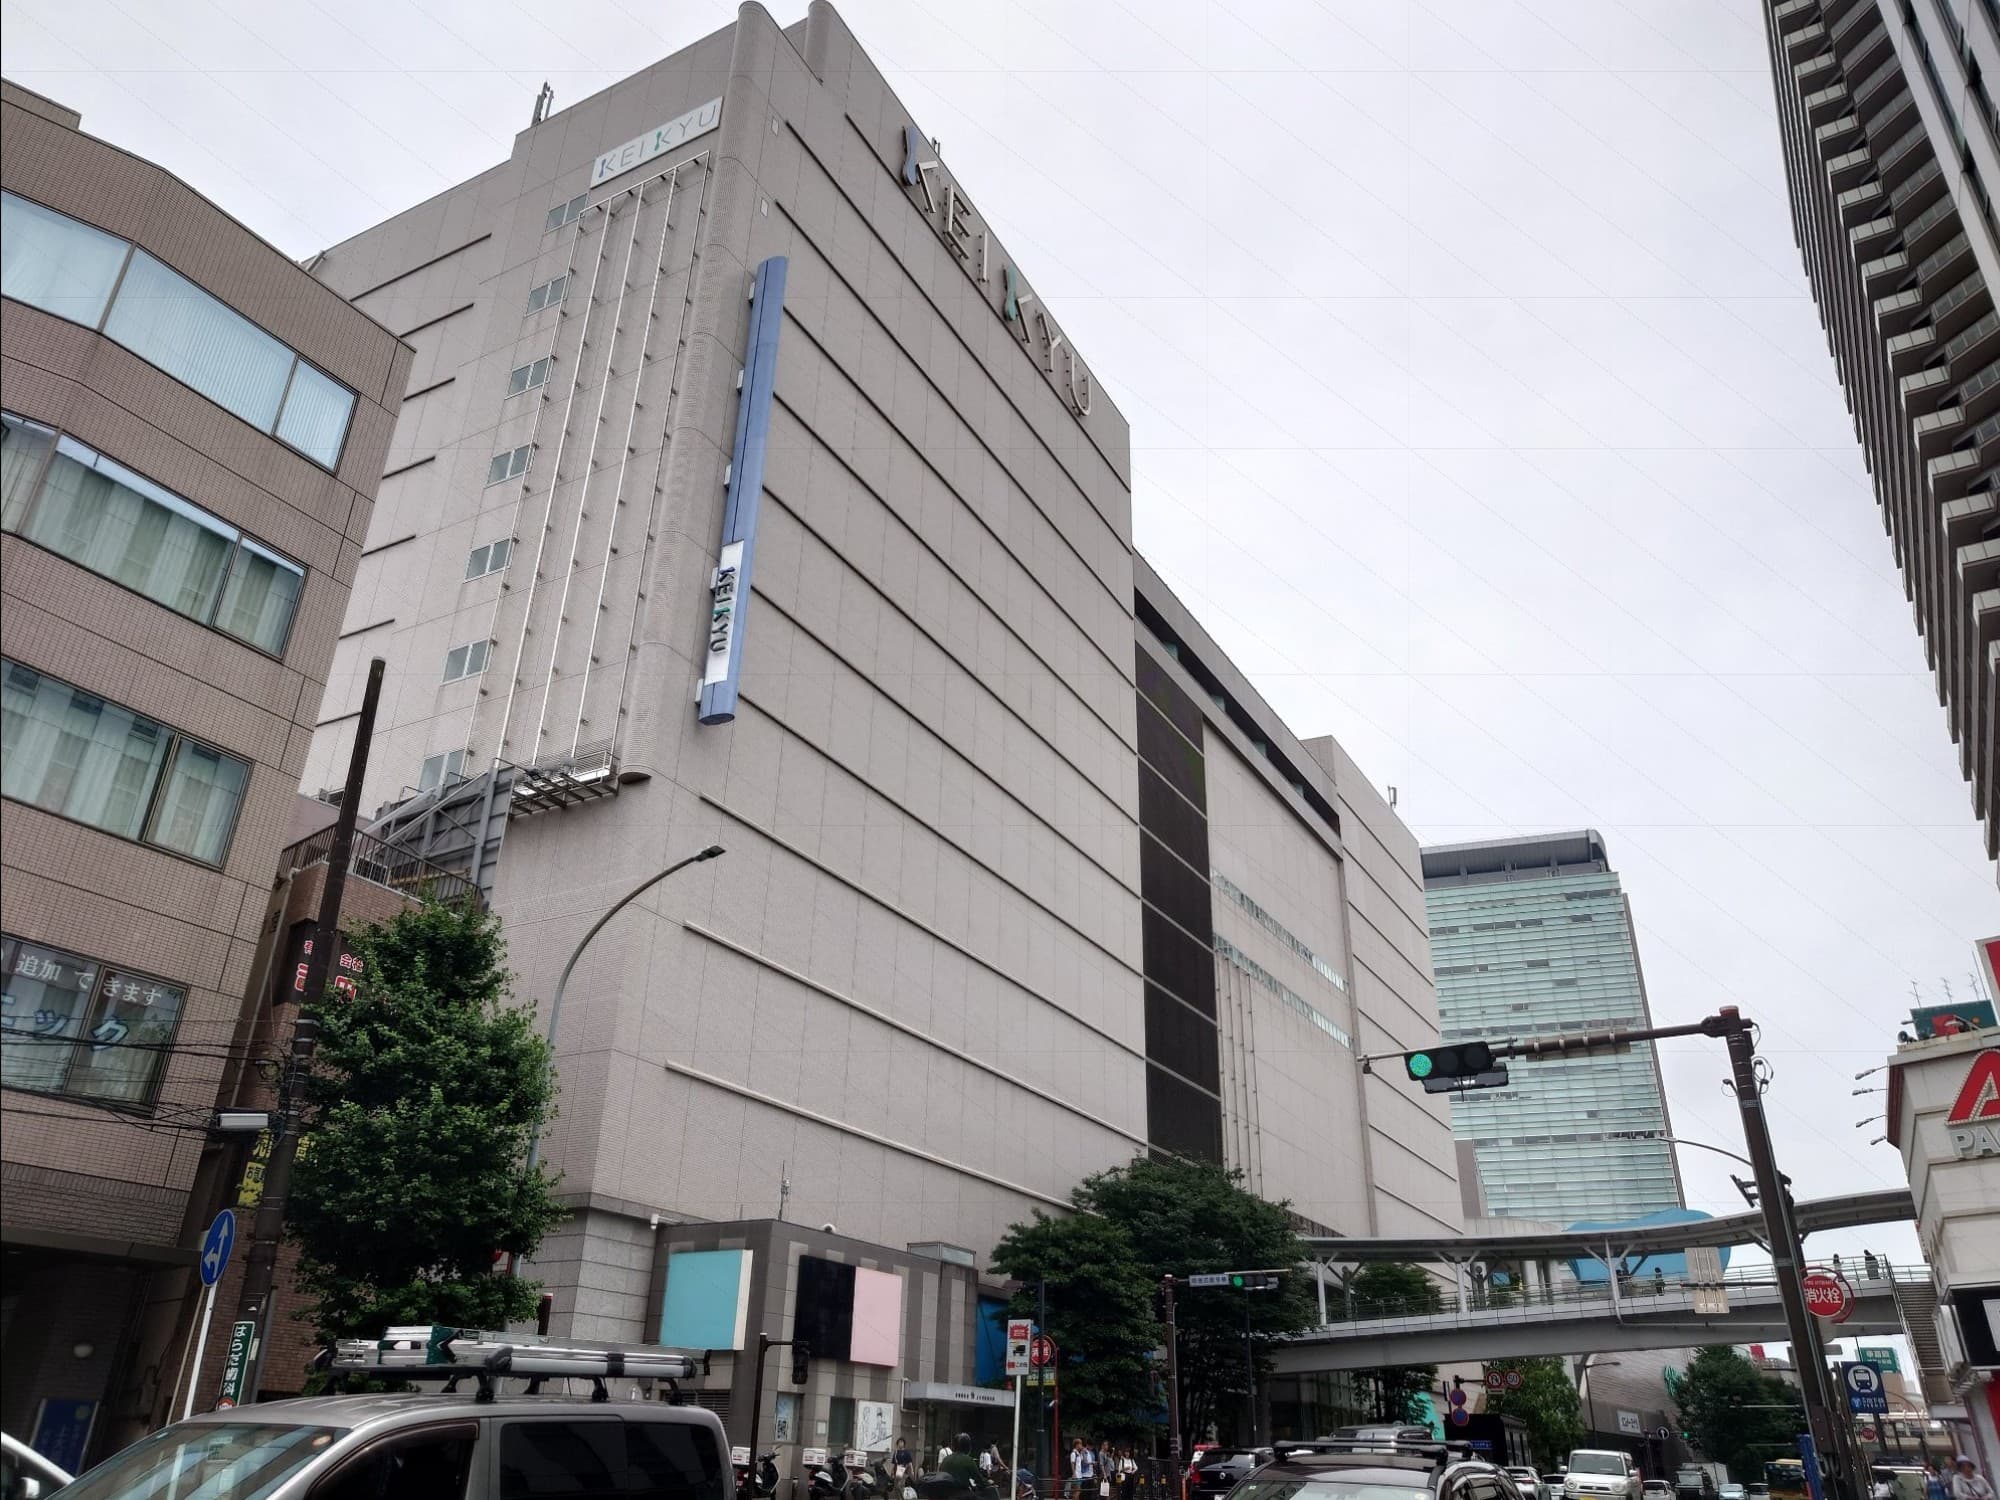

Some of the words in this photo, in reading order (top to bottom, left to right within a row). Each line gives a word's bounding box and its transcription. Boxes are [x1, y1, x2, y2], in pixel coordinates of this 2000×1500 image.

[304, 940, 364, 973] 有会社
[0, 948, 162, 1006] 追加できます
[1951, 1124, 2000, 1159] PA
[1804, 1287, 1842, 1304] 消火栓
[222, 1325, 248, 1396] はらだ歯科
